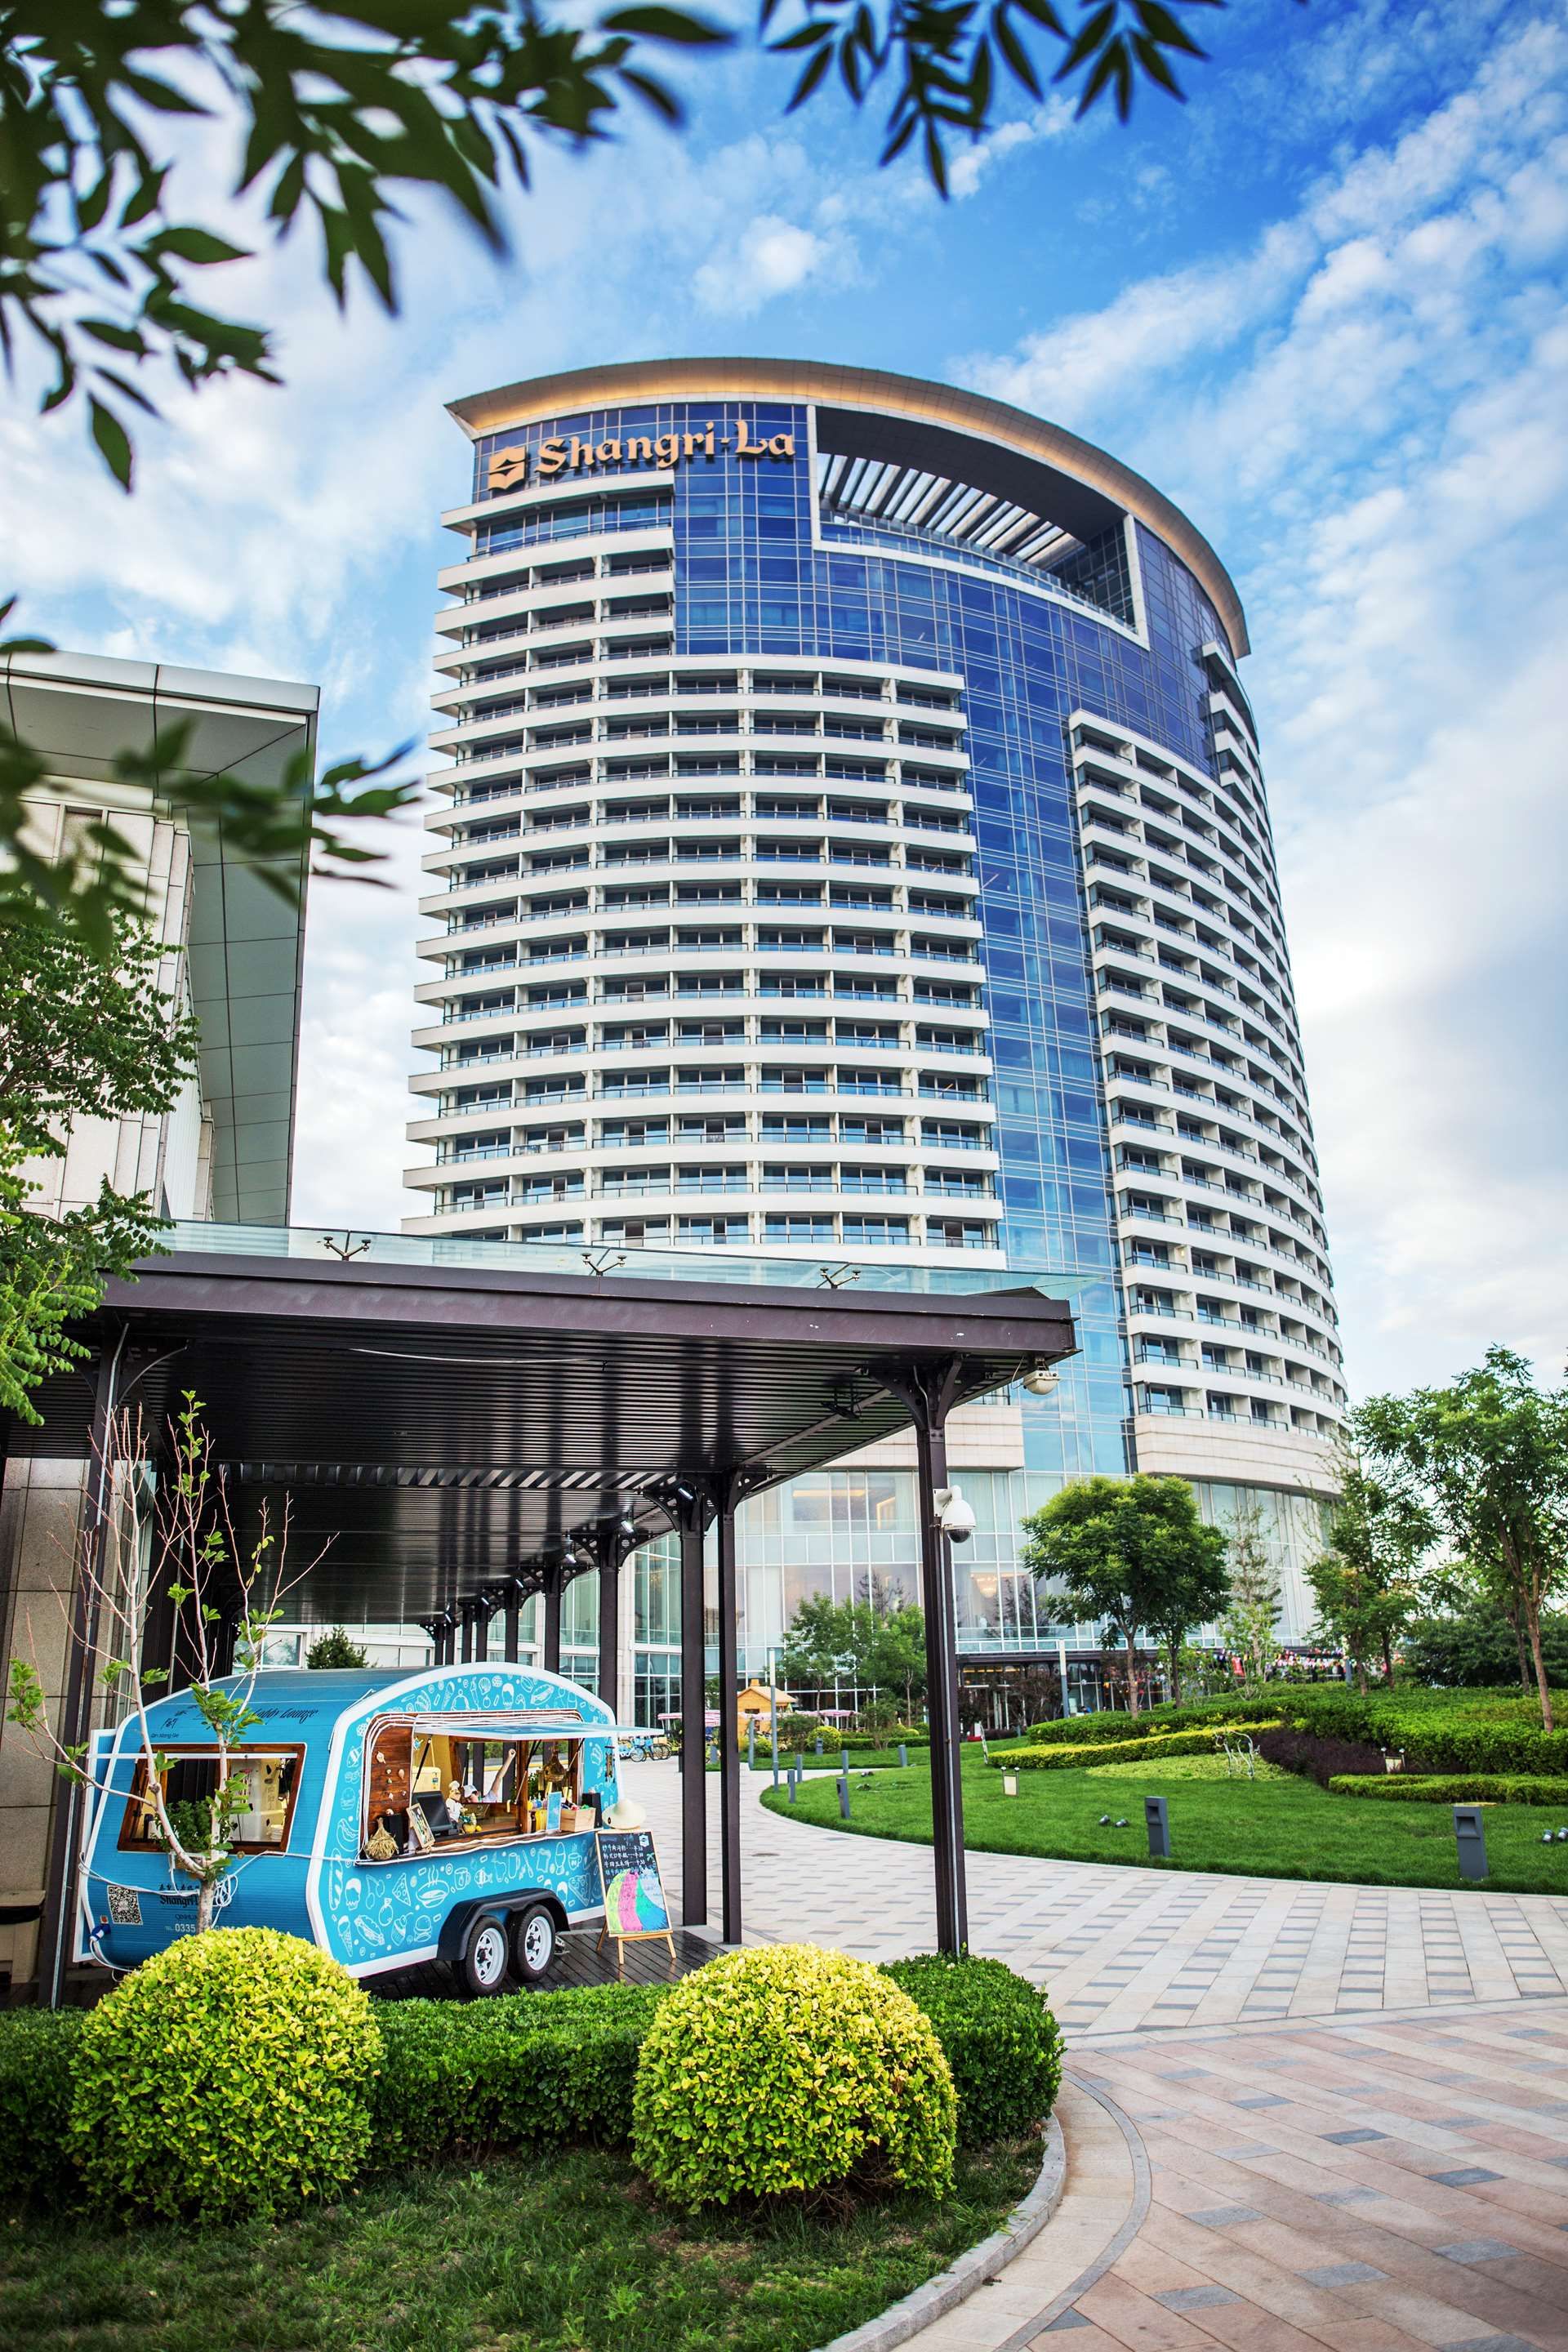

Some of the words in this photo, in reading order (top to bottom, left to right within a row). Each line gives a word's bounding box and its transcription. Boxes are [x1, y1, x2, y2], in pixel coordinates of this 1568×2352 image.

[534, 419, 796, 474] Shangri-La
[279, 1708, 319, 1724] Lounge
[175, 1923, 196, 1934] 0335
